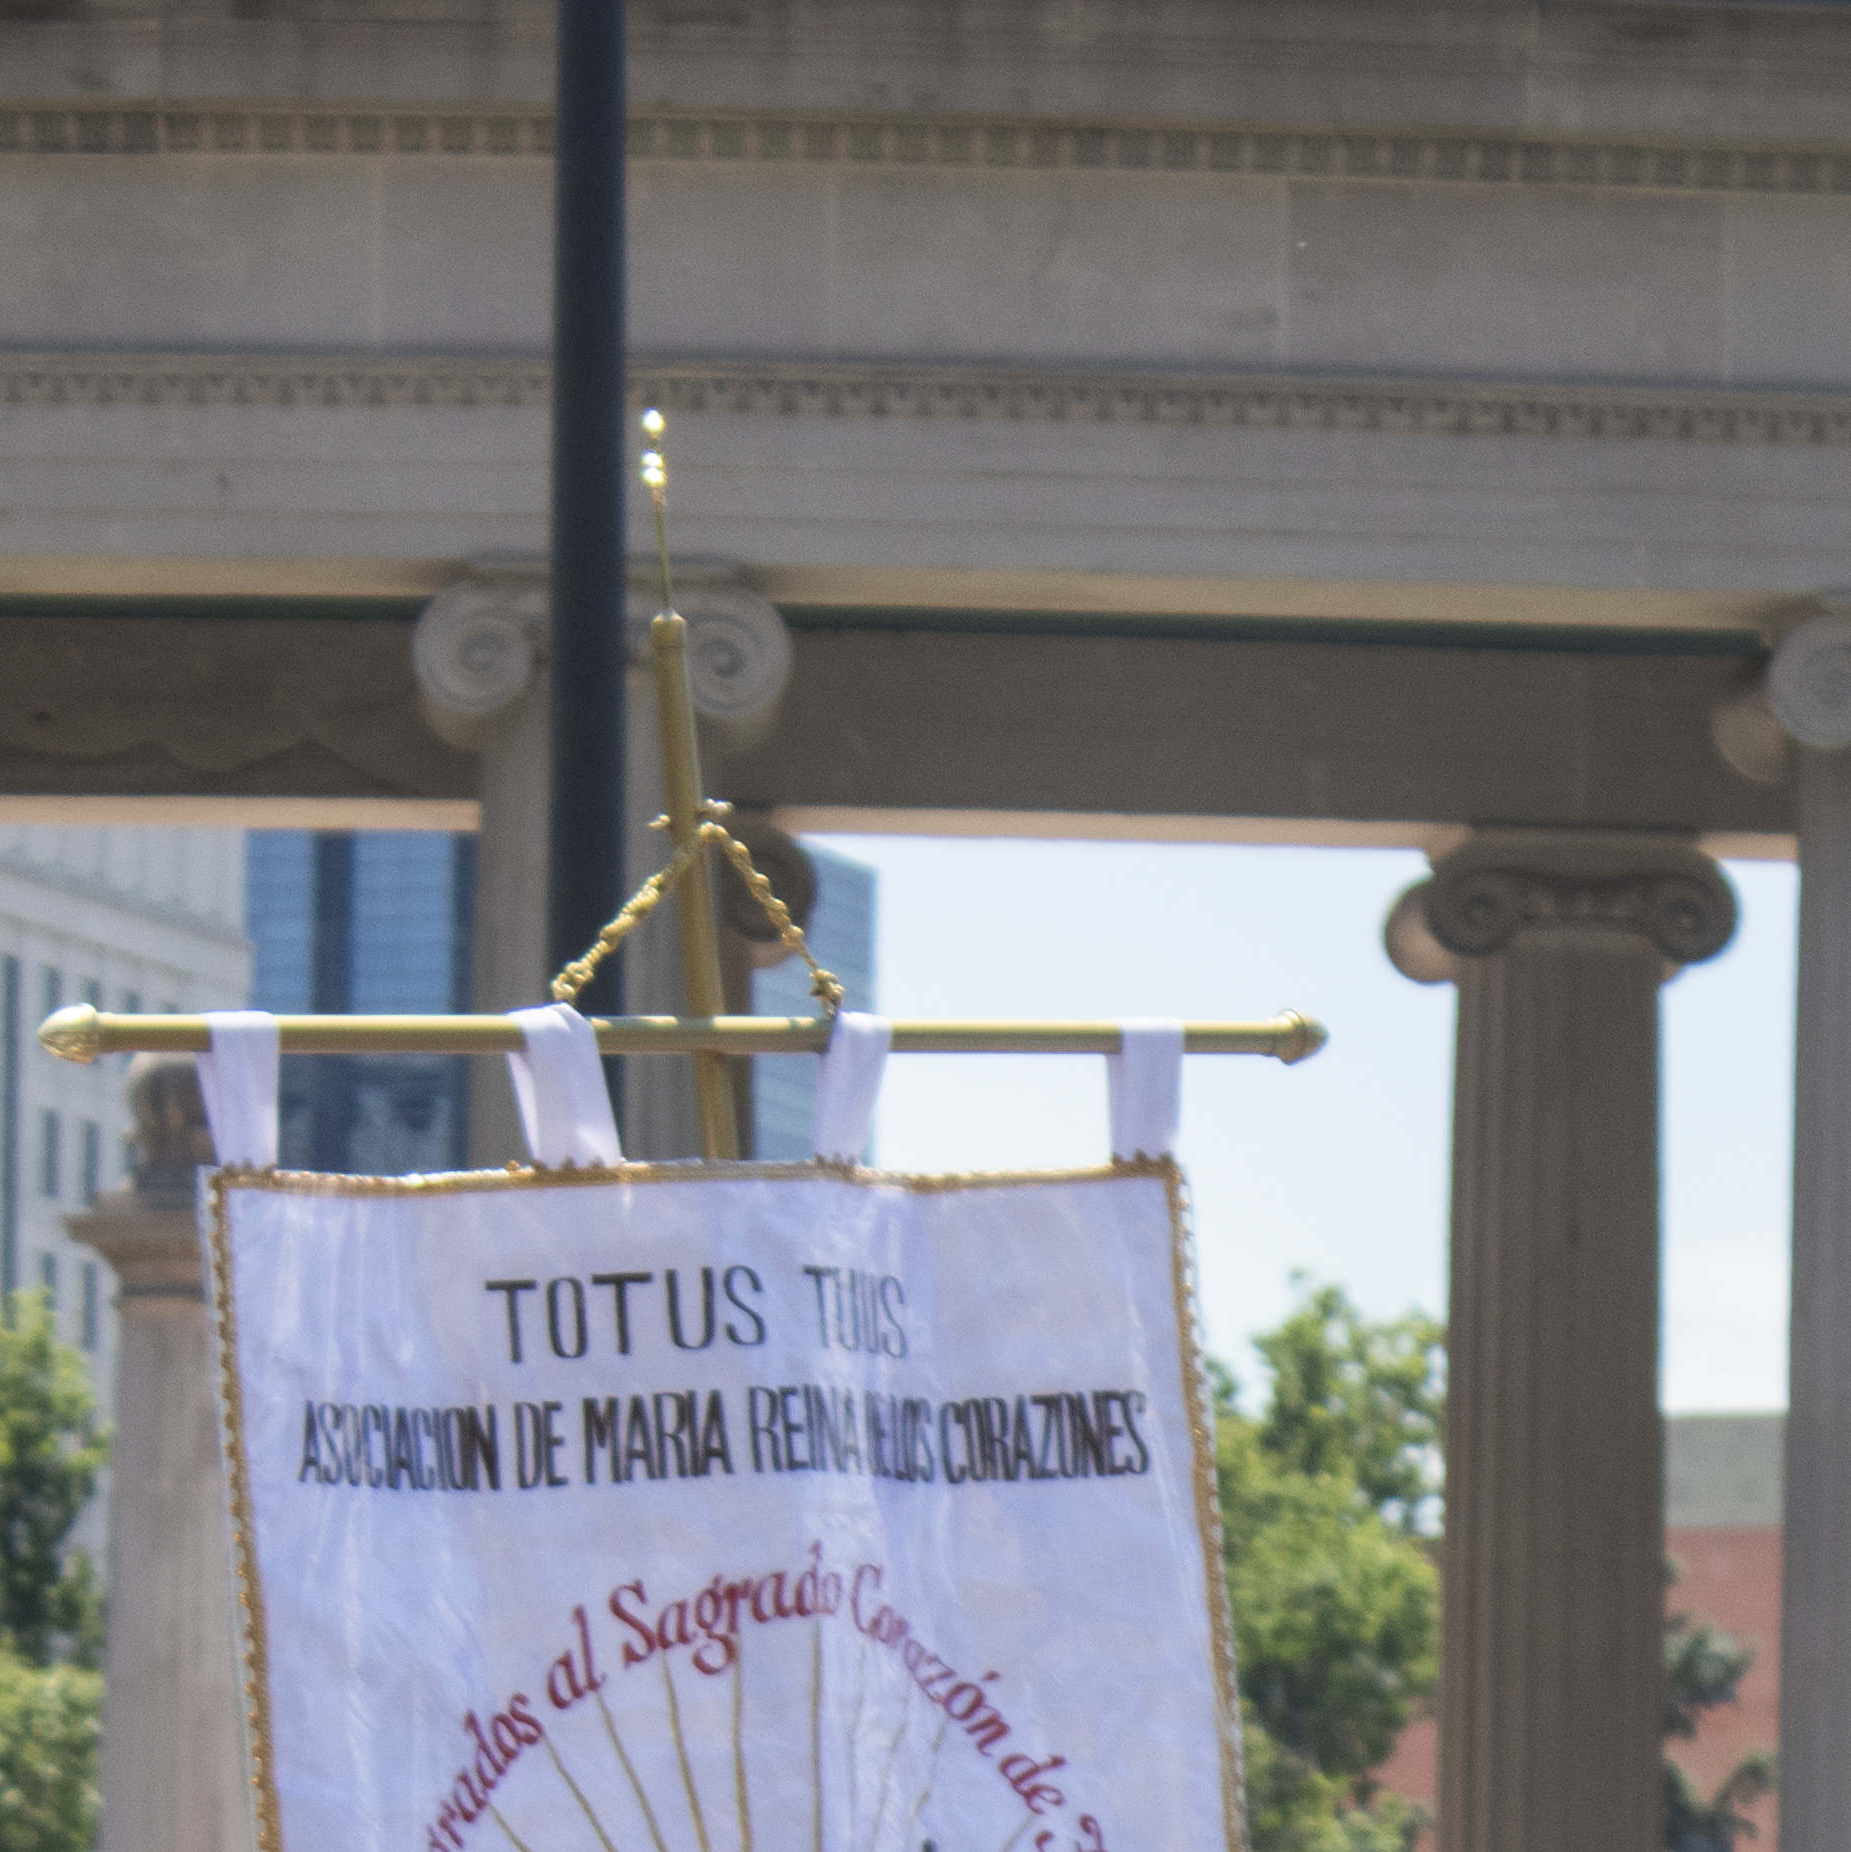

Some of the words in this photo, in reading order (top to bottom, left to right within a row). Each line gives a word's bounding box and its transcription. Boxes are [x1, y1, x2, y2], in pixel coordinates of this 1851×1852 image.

[484, 1264, 767, 1365] TOTUS
[802, 1263, 908, 1360] TUUS
[298, 1399, 502, 1491] ASOCIACION
[513, 1400, 569, 1490] DE
[581, 1388, 735, 1485] MARIA
[747, 1382, 862, 1475] REINA
[938, 1389, 1149, 1485] CORAZONES
[546, 1603, 607, 1711] al
[608, 1538, 842, 1678] Sagrado
[850, 1562, 1012, 1758] Corazón
[998, 1754, 1068, 1816] de
